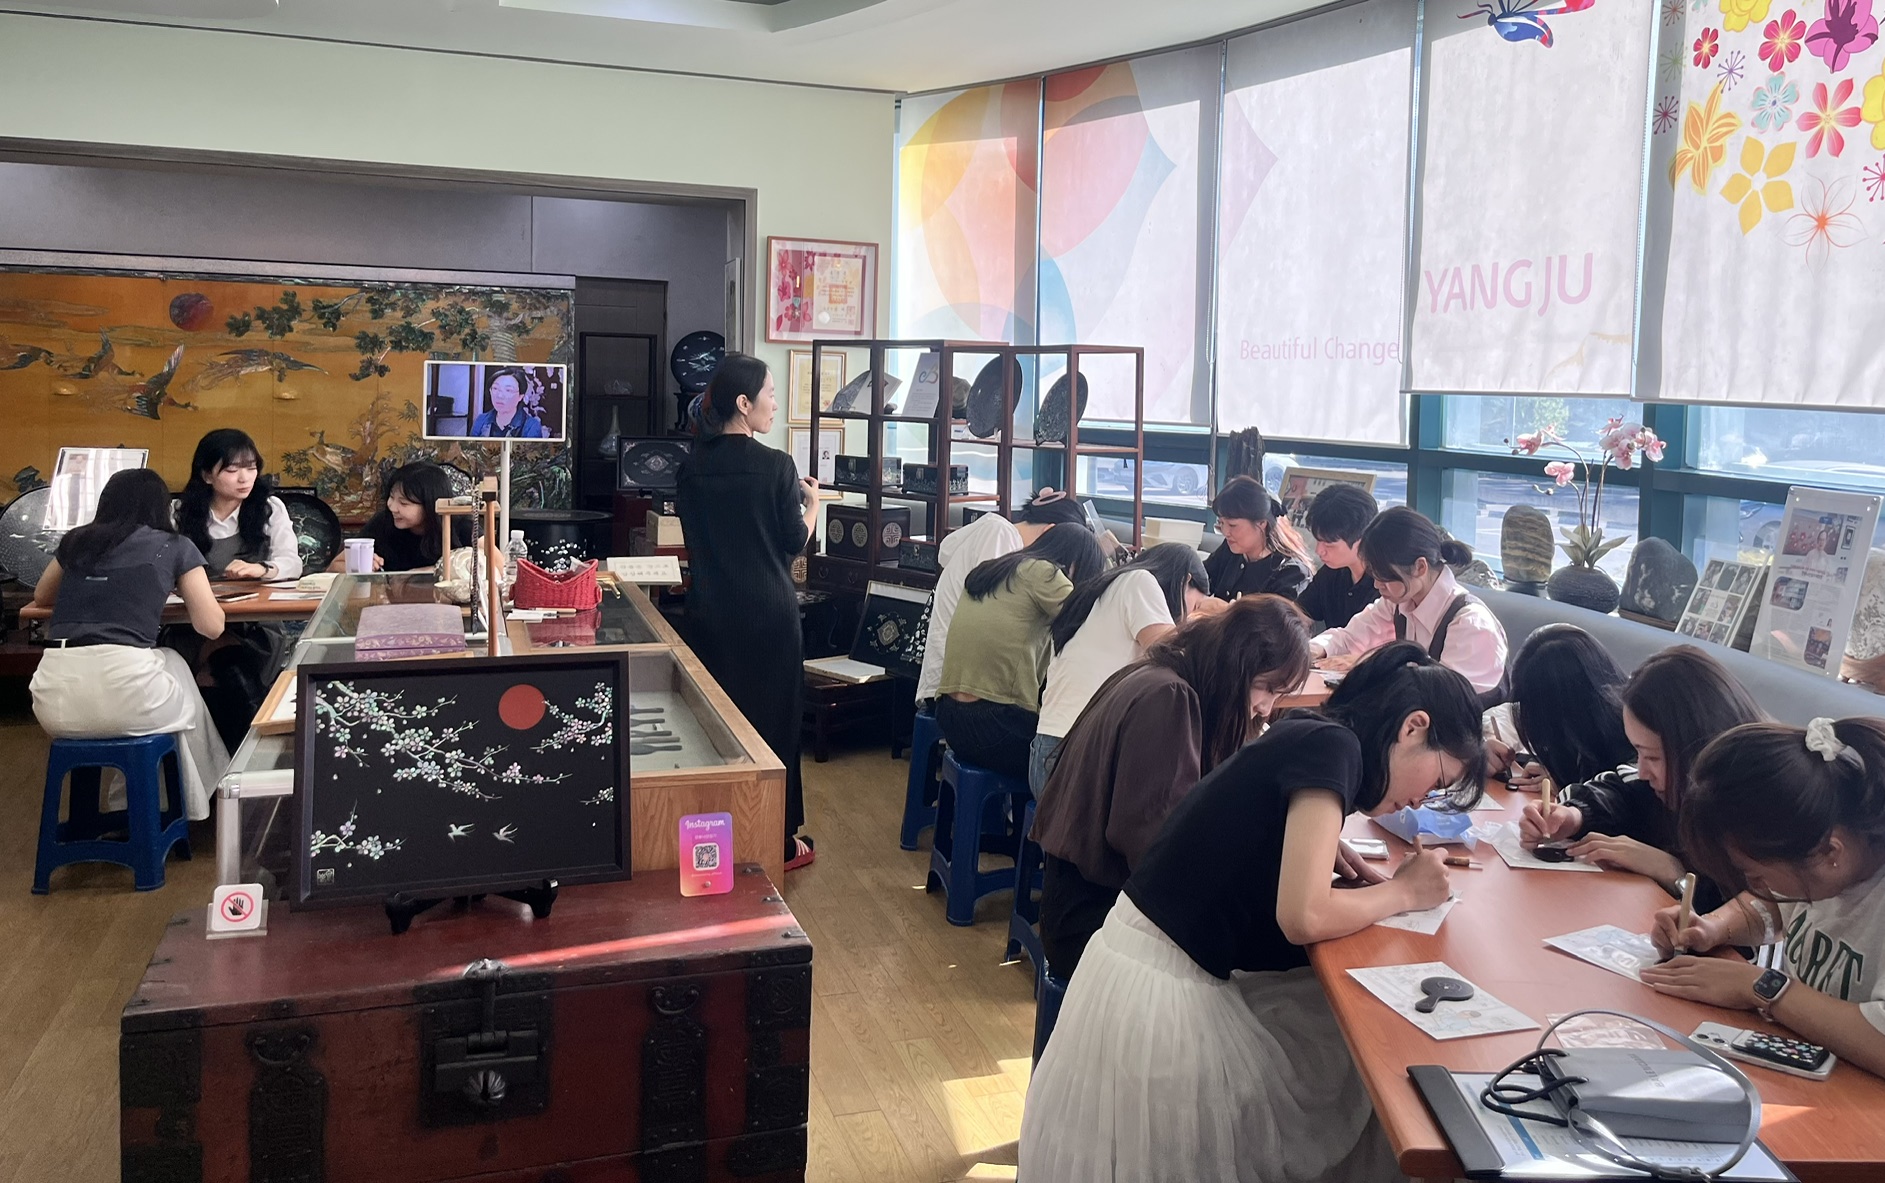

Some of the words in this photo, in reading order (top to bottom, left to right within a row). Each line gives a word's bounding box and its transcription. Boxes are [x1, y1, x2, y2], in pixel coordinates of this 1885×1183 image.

[1424, 252, 1594, 317] YANGJU
[1240, 336, 1317, 360] Beautiful
[1324, 336, 1399, 366] Change
[685, 819, 725, 831] Instagram
